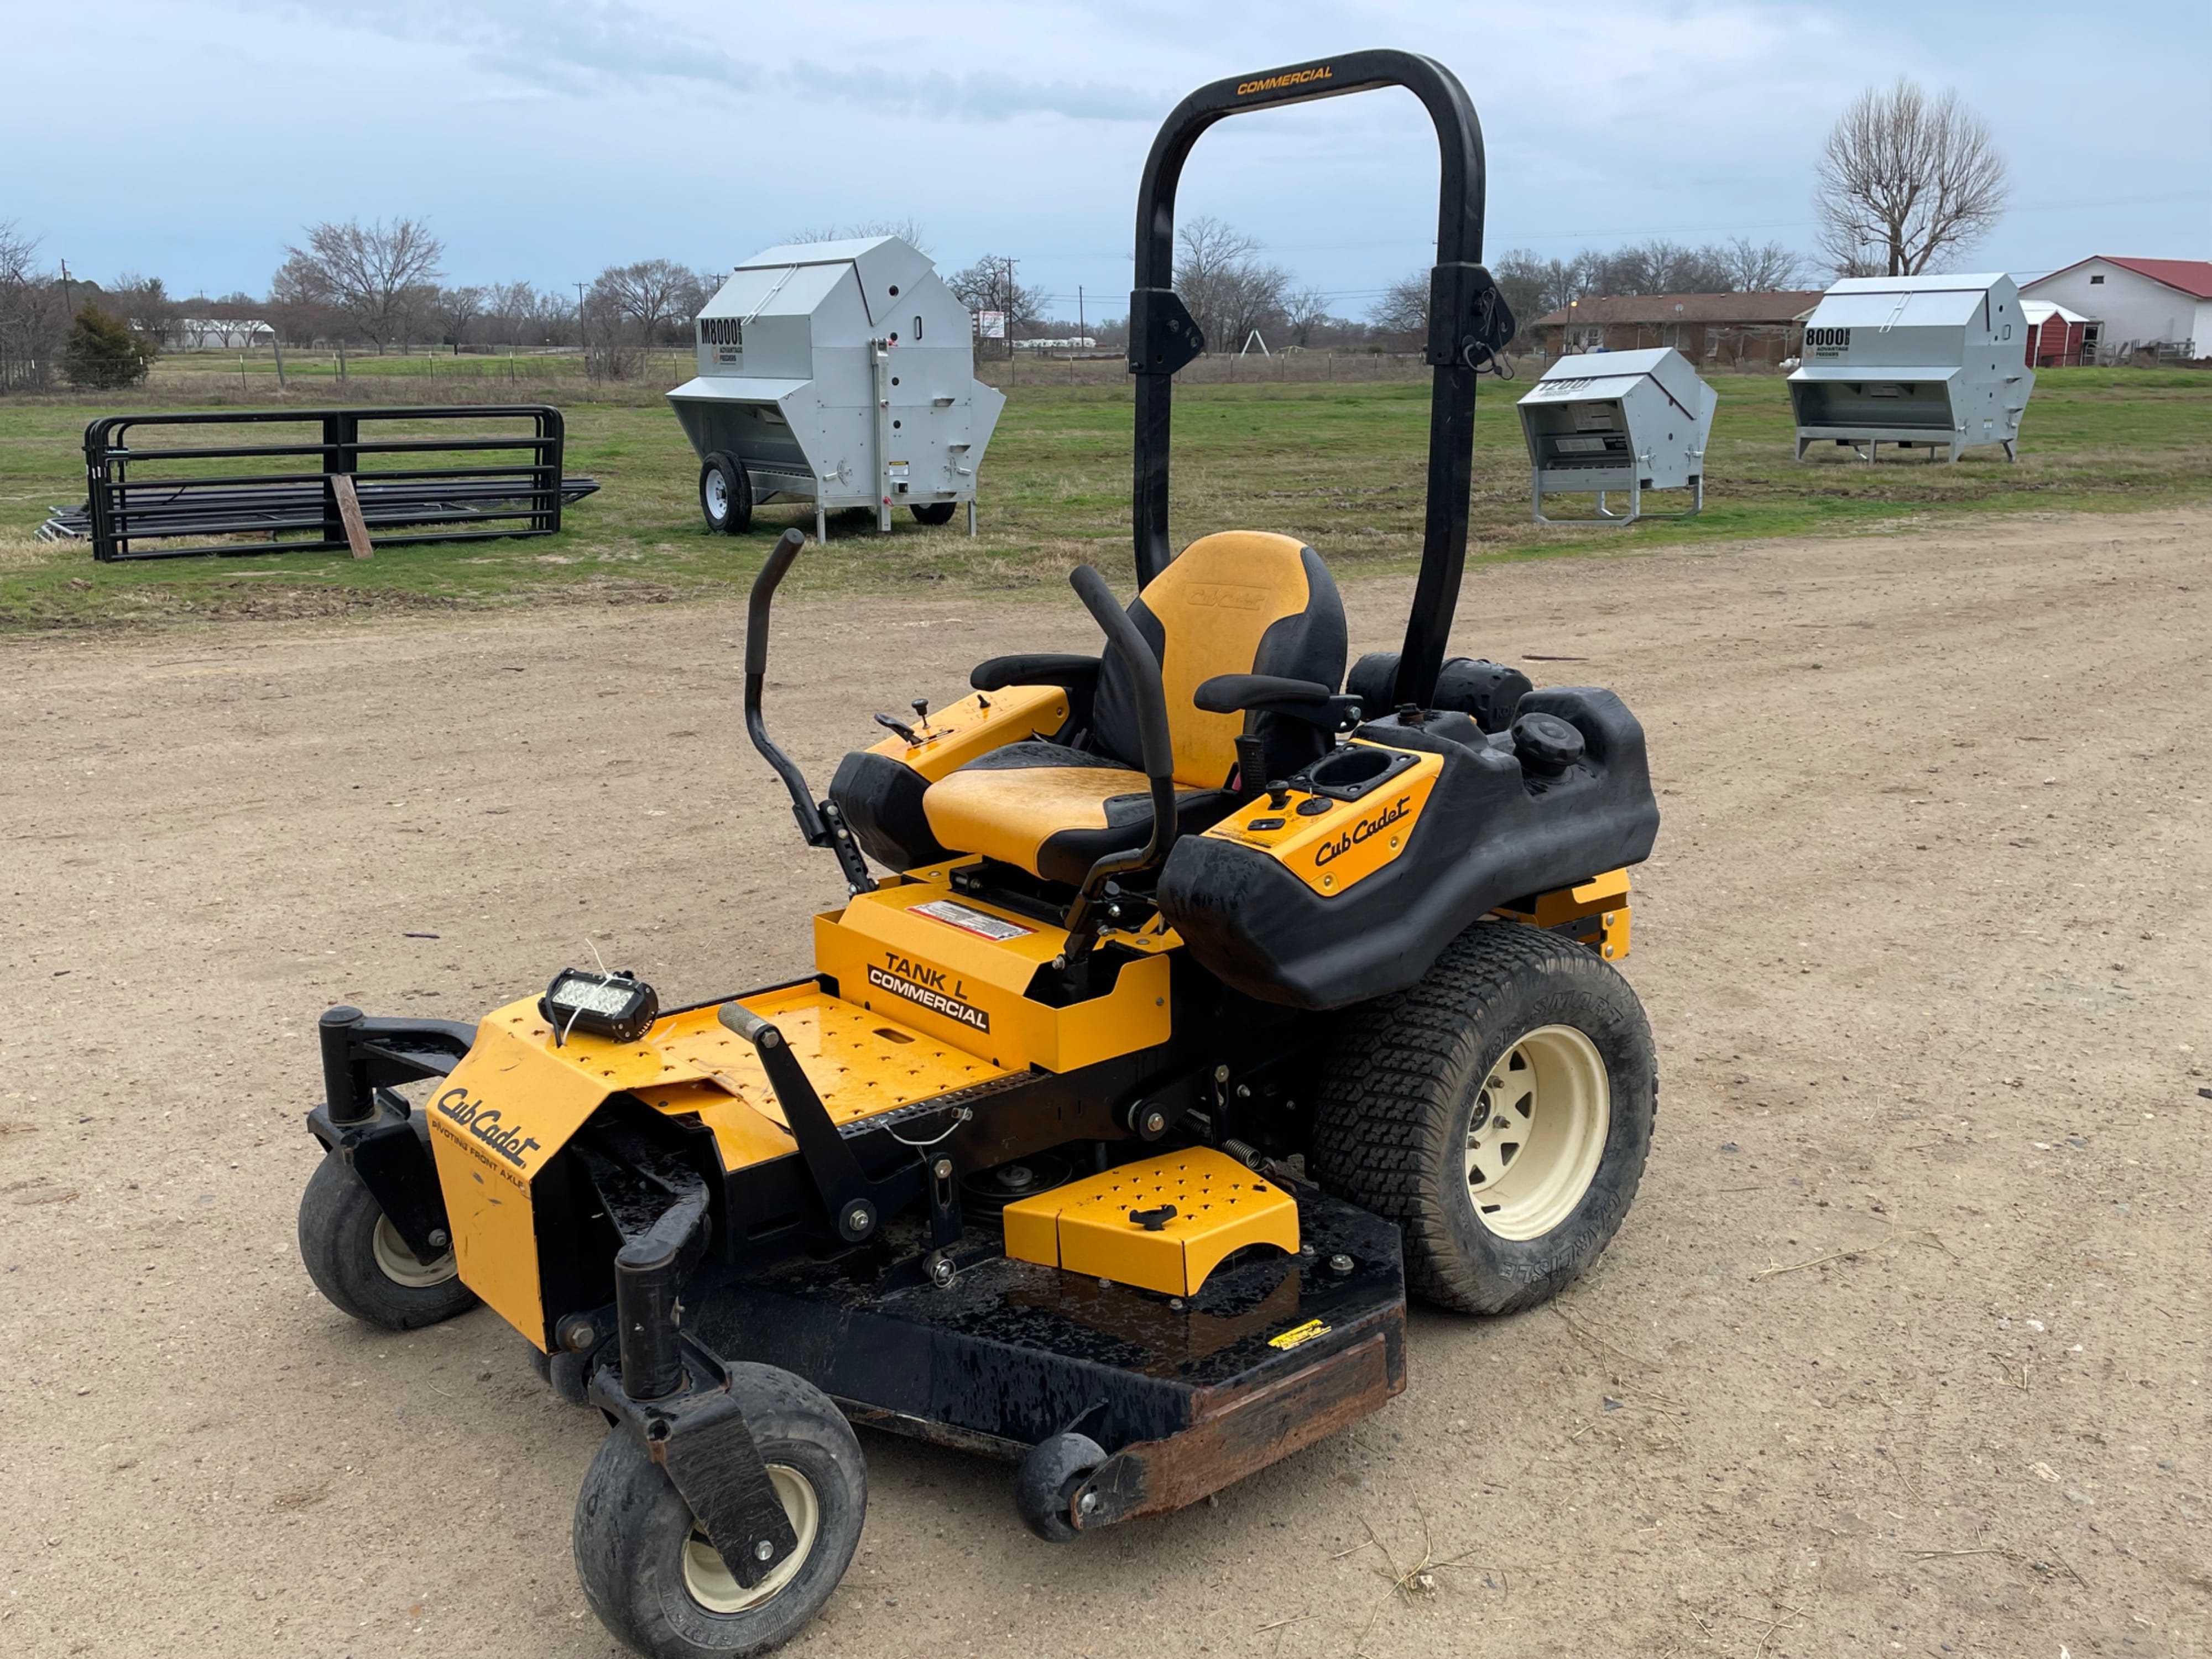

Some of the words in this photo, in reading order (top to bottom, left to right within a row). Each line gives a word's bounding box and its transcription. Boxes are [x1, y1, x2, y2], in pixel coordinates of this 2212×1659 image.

[1237, 66, 1333, 95] COMMERCIAL
[1315, 832, 1351, 866] Cub
[1353, 796, 1411, 844] Cadet
[869, 969, 987, 1029] COMMERCIAL
[885, 951, 946, 992] TANK
[954, 979, 968, 1000] L
[1532, 989, 1624, 1023] SMART
[431, 1119, 468, 1151] PIVOTING
[470, 1147, 498, 1171] FRONT
[500, 1169, 524, 1189] AXLE
[437, 1088, 483, 1126] Cub
[470, 1110, 541, 1167] Cadet
[1499, 1190, 1621, 1285] CARLISLE
